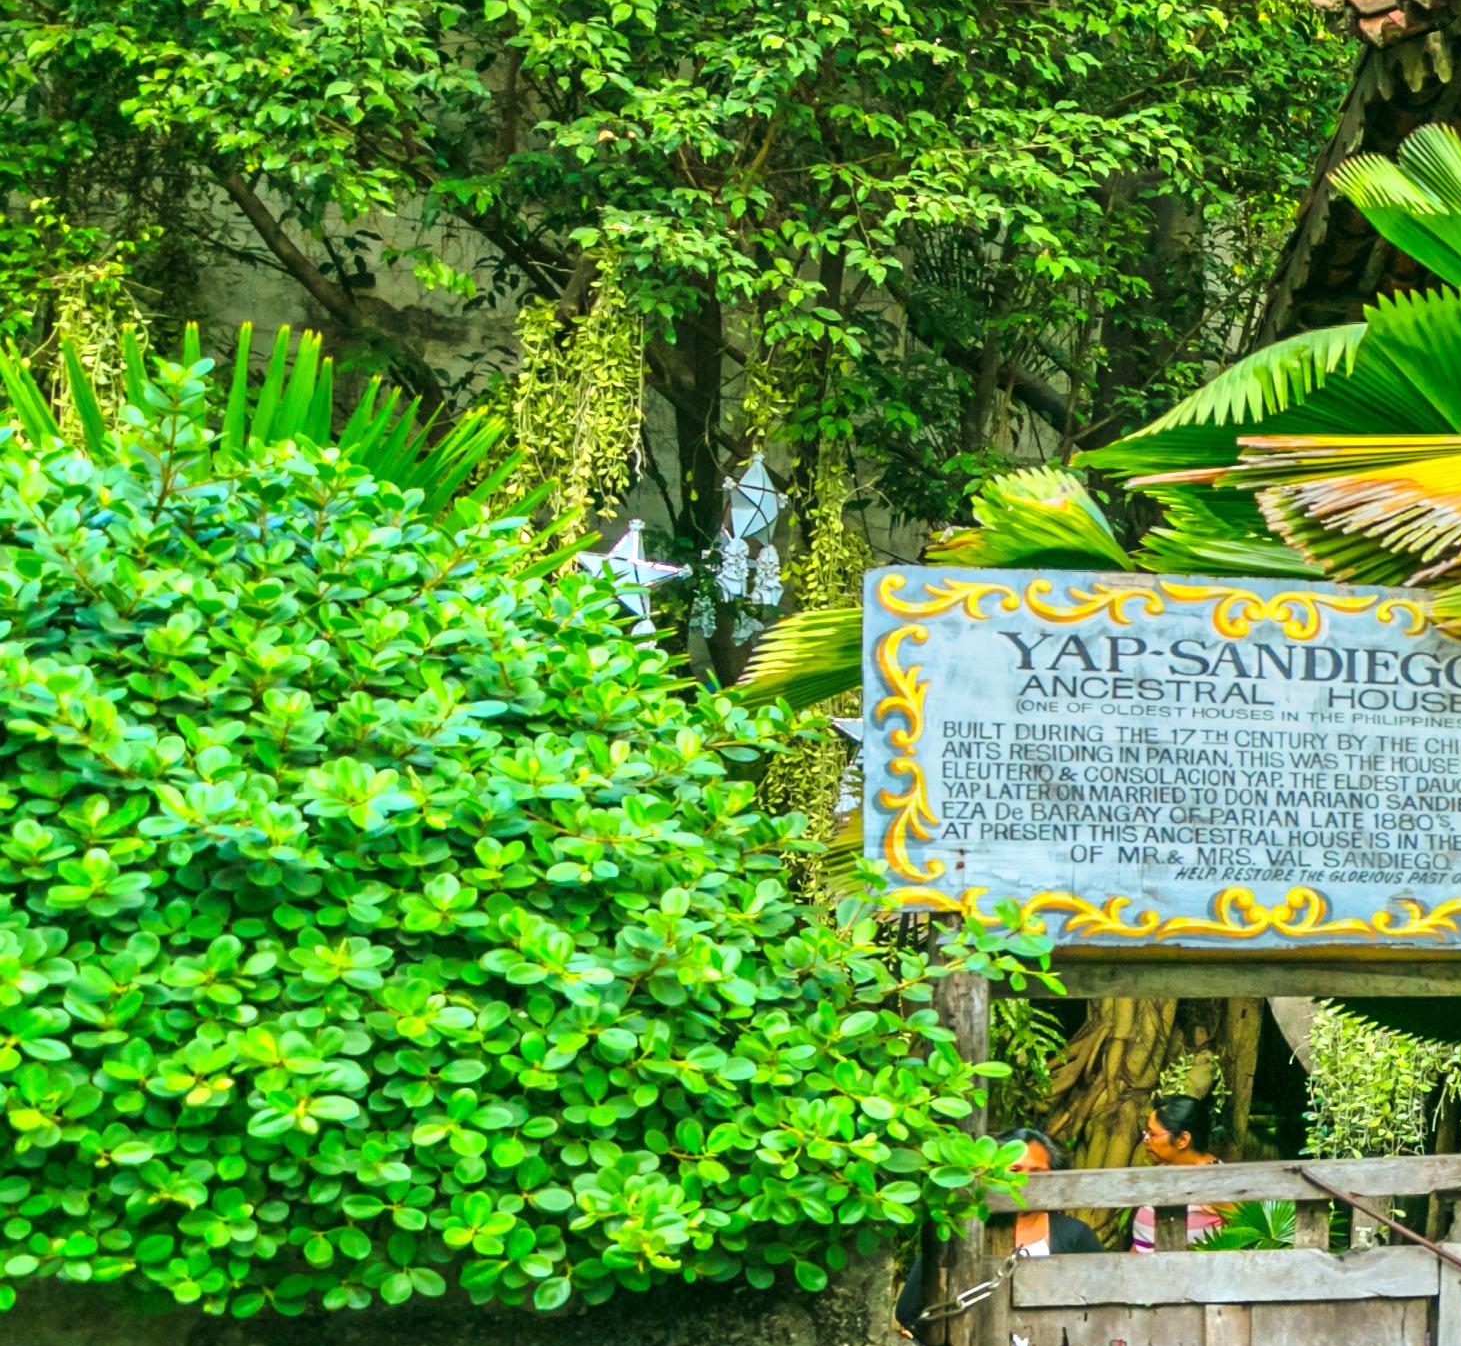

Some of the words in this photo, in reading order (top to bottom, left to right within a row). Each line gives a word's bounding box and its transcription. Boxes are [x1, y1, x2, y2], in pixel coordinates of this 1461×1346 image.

[1018, 674, 1275, 705] ANCESTRAL
[1015, 699, 1059, 715] (ONE
[1066, 701, 1094, 715] OF
[1101, 703, 1184, 718] OLDEST
[1192, 706, 1275, 722] HOUSES
[1281, 710, 1299, 722] IN
[1308, 711, 1347, 724] THE
[942, 721, 1006, 739] BUILT
[1014, 723, 1104, 743] DURING
[1115, 726, 1159, 745] THE
[1233, 729, 1329, 751] CENTURY
[1337, 734, 1369, 751] BY
[1377, 735, 1418, 753] THE
[942, 741, 1002, 759] ANTS
[1009, 743, 1113, 764] RESIDING
[1118, 746, 1140, 764] IN
[1146, 748, 1234, 769] PARIAN,
[1237, 750, 1285, 769] THIS
[1290, 752, 1340, 771] WAS
[1347, 753, 1387, 772] THE
[1391, 755, 1460, 774] HOUSE
[941, 761, 1054, 782] ELEUTERIO
[1059, 767, 1079, 782] &
[1083, 766, 1236, 787] CONSOLACION
[1288, 770, 1327, 789] THE
[1334, 773, 1412, 793] ELDEST
[941, 781, 981, 800] YAP
[986, 782, 1051, 802] LATER
[1056, 784, 1085, 802] ON
[1089, 785, 1187, 805] MARRIED
[1190, 788, 1218, 805] TO
[1224, 788, 1268, 807] DON
[1276, 789, 1380, 810] MARIANO
[941, 802, 987, 820] EZA
[995, 803, 1024, 821] De
[1030, 804, 1162, 824] BARANGAY
[1168, 807, 1202, 825] OF
[1208, 808, 1300, 829] PARIAN
[1310, 811, 1364, 830] LATE
[941, 823, 970, 840] AT
[980, 824, 1083, 843] PRESENT
[1087, 825, 1139, 844] THIS
[1143, 826, 1284, 848] ANCESTRAL
[1288, 830, 1362, 849] HOUSE
[1368, 833, 1387, 850] IS
[1397, 833, 1418, 851] IN
[1070, 844, 1104, 864] OF
[1197, 846, 1257, 867] MRS.
[1266, 848, 1312, 868] VAL
[1175, 866, 1218, 881] HELP
[1221, 867, 1294, 882] RESTORE
[1300, 869, 1327, 883] THE
[1330, 870, 1404, 884] GLORIOUS
[1407, 871, 1448, 885] PAST
